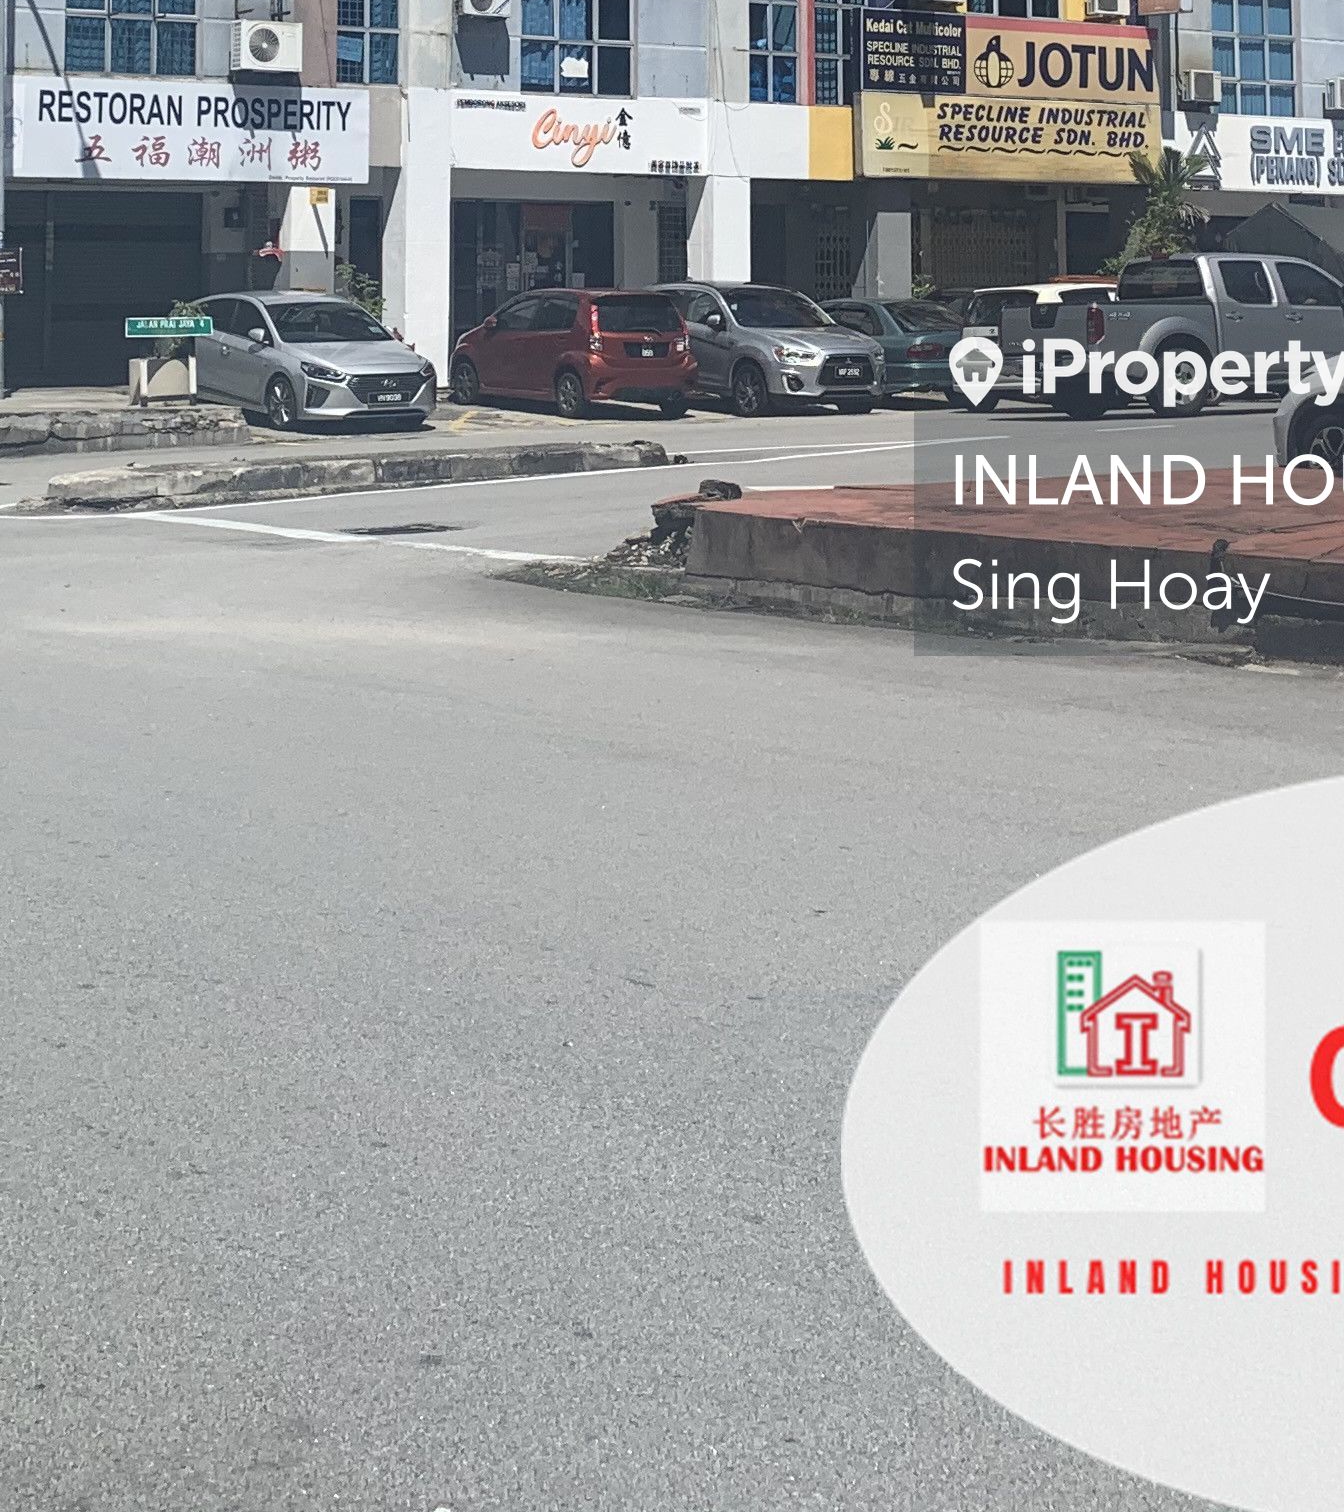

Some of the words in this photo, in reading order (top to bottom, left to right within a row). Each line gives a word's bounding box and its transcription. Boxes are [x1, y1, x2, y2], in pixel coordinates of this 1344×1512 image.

[866, 18, 894, 33] Kedai
[896, 20, 913, 34] Cat
[916, 21, 962, 37] Multicolor
[867, 40, 909, 53] SPECLINE
[911, 43, 962, 57] INDUSTRIAL
[867, 54, 915, 67] RESOURCE
[1017, 41, 1154, 92] JOTUN
[38, 89, 182, 127] RESTORAN
[196, 96, 352, 131] PROSPERITY
[936, 103, 1030, 124] SPECLINE
[1037, 107, 1146, 129] INDUSTRIAL
[938, 123, 1044, 144] RESOURCE
[1053, 128, 1096, 146] SDN.
[1106, 130, 1149, 148] BHD.
[1250, 126, 1325, 156] SME
